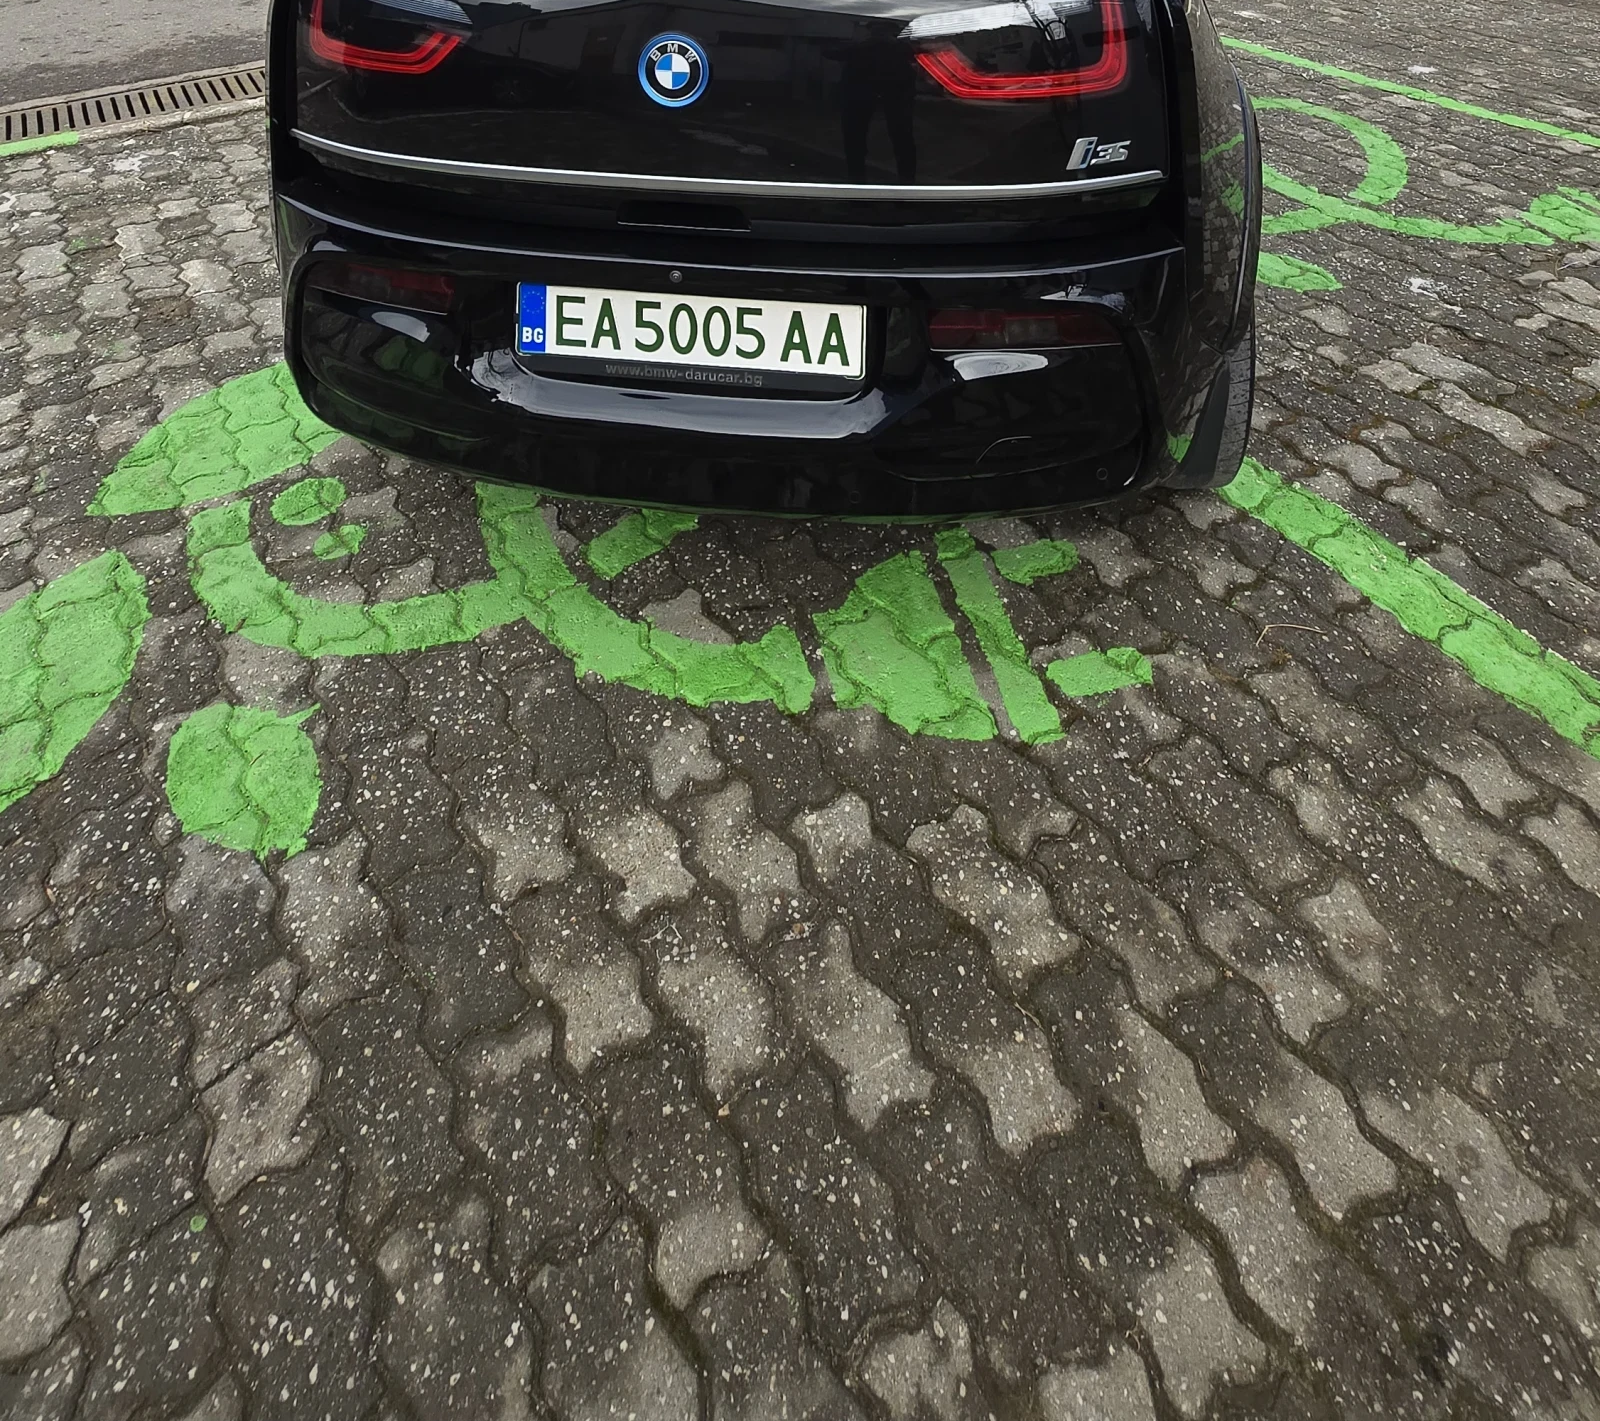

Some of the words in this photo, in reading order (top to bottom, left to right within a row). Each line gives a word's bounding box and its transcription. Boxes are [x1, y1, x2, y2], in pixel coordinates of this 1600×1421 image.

[650, 43, 697, 63] BMW
[522, 326, 544, 343] BG
[556, 295, 621, 350] EA
[635, 300, 766, 360] 5005
[780, 310, 850, 367] AA
[605, 364, 763, 387] www.bmw-darucar.bg
